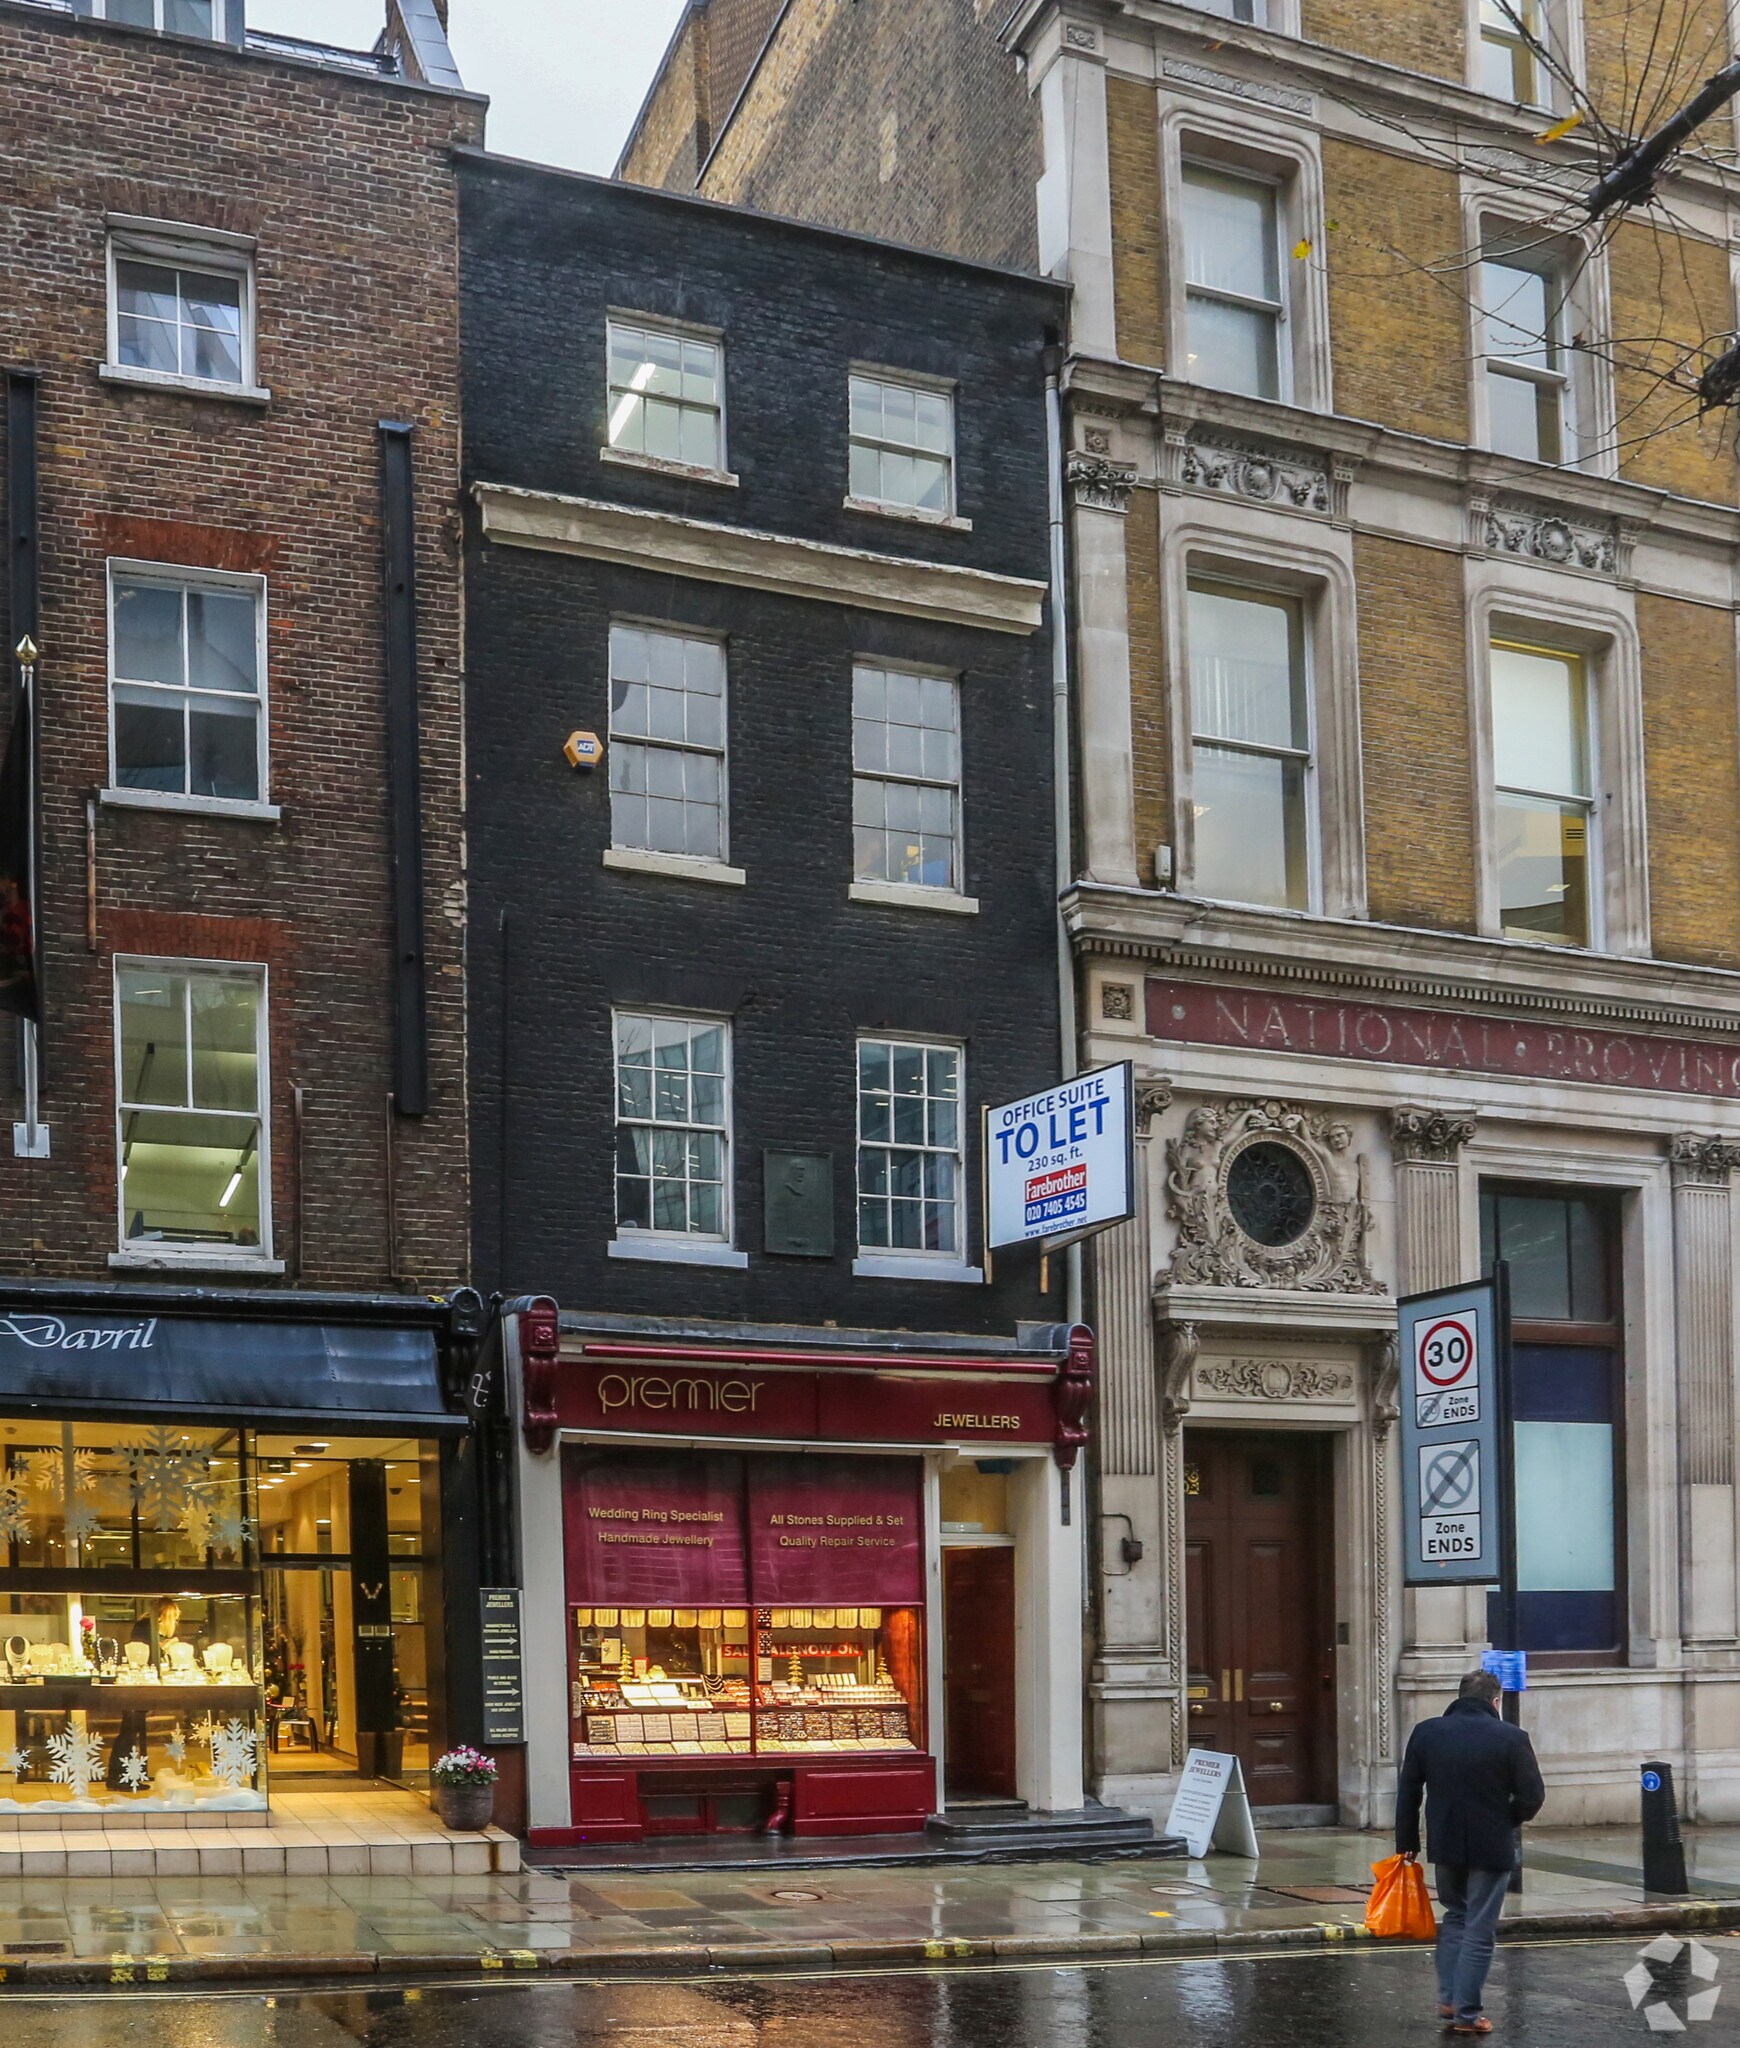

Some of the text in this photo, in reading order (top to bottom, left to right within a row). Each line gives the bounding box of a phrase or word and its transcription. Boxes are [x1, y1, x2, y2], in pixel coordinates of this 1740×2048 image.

[1215, 994, 1502, 1067] NATIONAL
[1003, 1078, 1104, 1126] OFFICE SUITE
[996, 1096, 1110, 1165] TO LET
[1028, 1146, 1083, 1172] 230 sq. ft.
[1026, 1169, 1085, 1200] Farebrother
[1027, 1192, 1085, 1222] 020 7405 4545
[1025, 1216, 1088, 1238] www.farebrother.net
[0, 1312, 158, 1349] Davril
[1428, 1337, 1465, 1367] 30
[1449, 1396, 1469, 1405] Zone
[1443, 1405, 1476, 1419] ENDS
[934, 1414, 1020, 1429] JEWELLERS
[588, 1507, 723, 1523] Wedding Ring Specialist
[770, 1514, 903, 1527] All Stones Supplied & Set
[1435, 1522, 1465, 1535] Zone
[598, 1532, 714, 1547] Handmade Jewellery
[779, 1535, 895, 1548] Quality Repair Service
[1428, 1537, 1474, 1554] ENDS
[724, 1645, 749, 1657] SAL
[798, 1644, 831, 1655] NOW
[838, 1644, 859, 1655] ON
[1188, 1766, 1222, 1777] JEWELLERS
[1194, 1759, 1221, 1769] PREMIER
